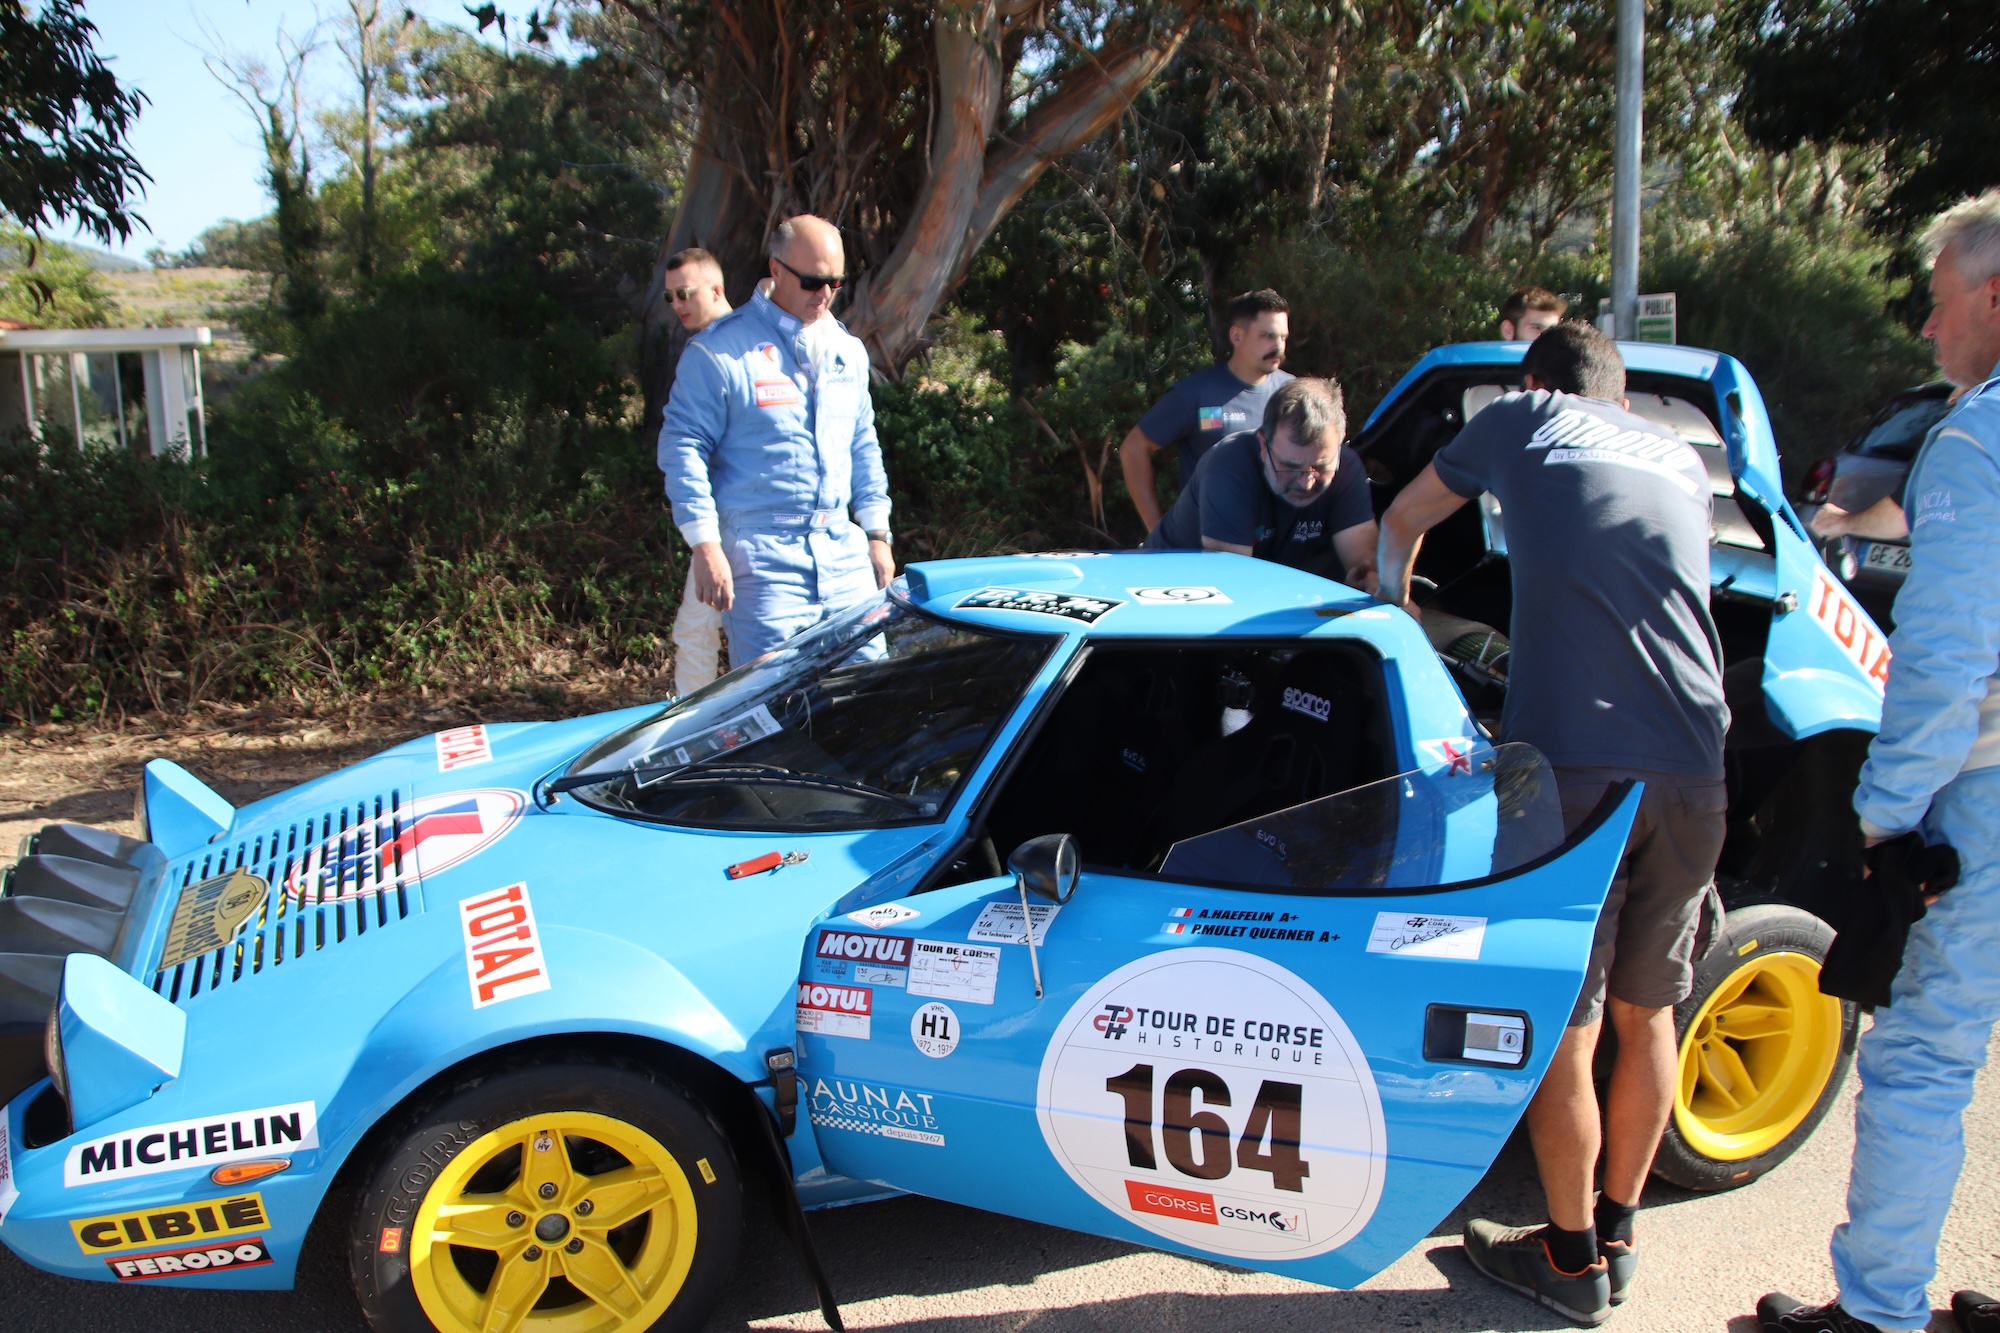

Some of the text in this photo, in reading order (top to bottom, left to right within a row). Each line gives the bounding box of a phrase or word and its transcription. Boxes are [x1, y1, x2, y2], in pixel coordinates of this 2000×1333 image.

[1645, 299, 1673, 315] PUBLIC
[1554, 449, 1565, 460] by
[1283, 686, 1331, 717] sparco
[1257, 829, 1276, 846] EVO
[1198, 909, 1300, 922] A.HAEFELIN A+
[180, 914, 224, 958] CORSE
[465, 885, 541, 1002] TOTAL
[820, 933, 906, 962] MOTUL
[1190, 923, 1341, 943] P.MULET QUERNER A+
[917, 943, 944, 954] TOUR
[946, 946, 960, 955] DE
[797, 983, 868, 1011] MOTUL
[931, 1005, 945, 1013] VHC
[921, 1013, 951, 1041] H1
[1137, 1008, 1198, 1033] TOUR
[1206, 1015, 1236, 1038] DE
[1244, 1020, 1324, 1048] CORSE
[1138, 1031, 1323, 1065] HISTORIQUE
[807, 1097, 939, 1130] LASSIQUE
[1106, 1063, 1310, 1193] 164
[80, 1112, 302, 1175] MICHELIN
[886, 1128, 941, 1143] depuis 1967
[80, 1197, 265, 1248] CIBIÉ
[1145, 1193, 1213, 1215] CORSE
[1220, 1206, 1268, 1224] GSM
[383, 1230, 399, 1250] D7
[114, 1244, 263, 1278] FERODO
